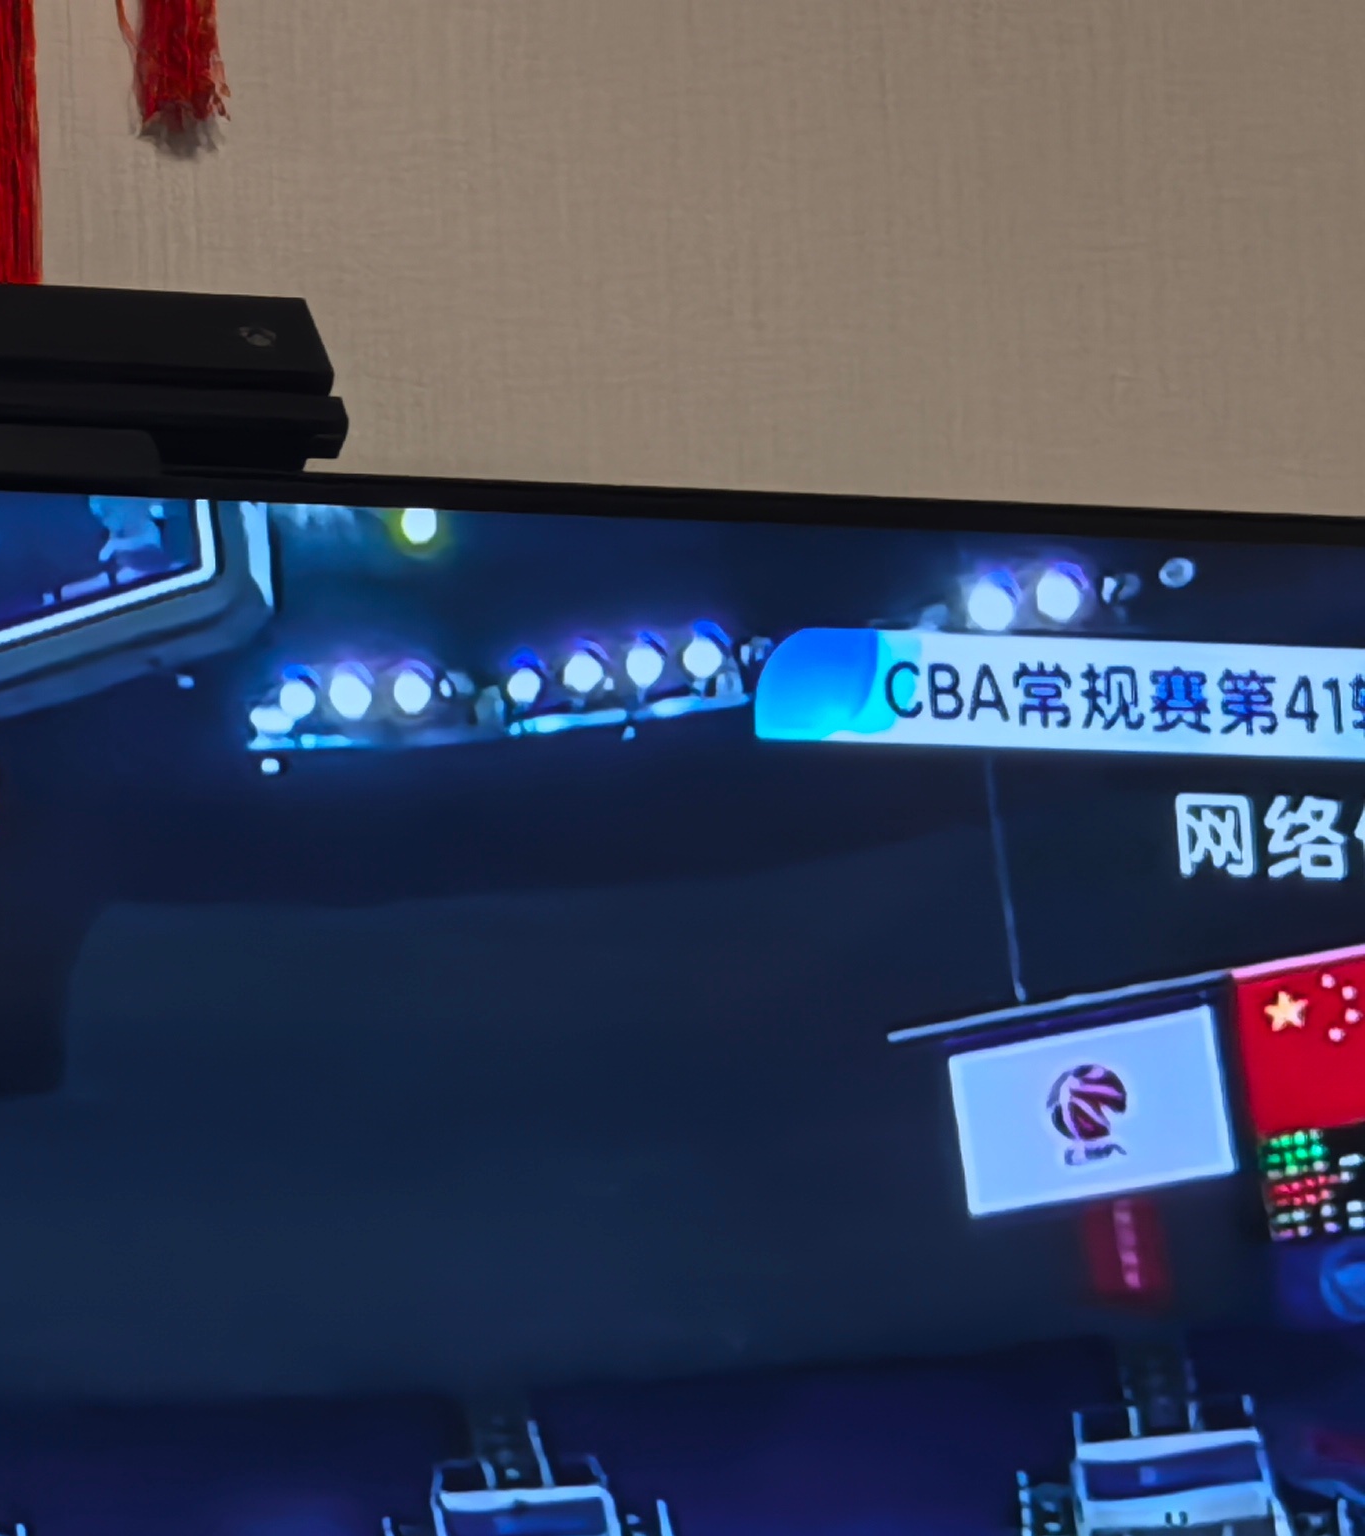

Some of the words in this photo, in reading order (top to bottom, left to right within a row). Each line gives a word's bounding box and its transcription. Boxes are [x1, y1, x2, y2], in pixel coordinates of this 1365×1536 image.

[884, 660, 1365, 736] CBA常规赛第41
[1174, 792, 1365, 881] 网络
